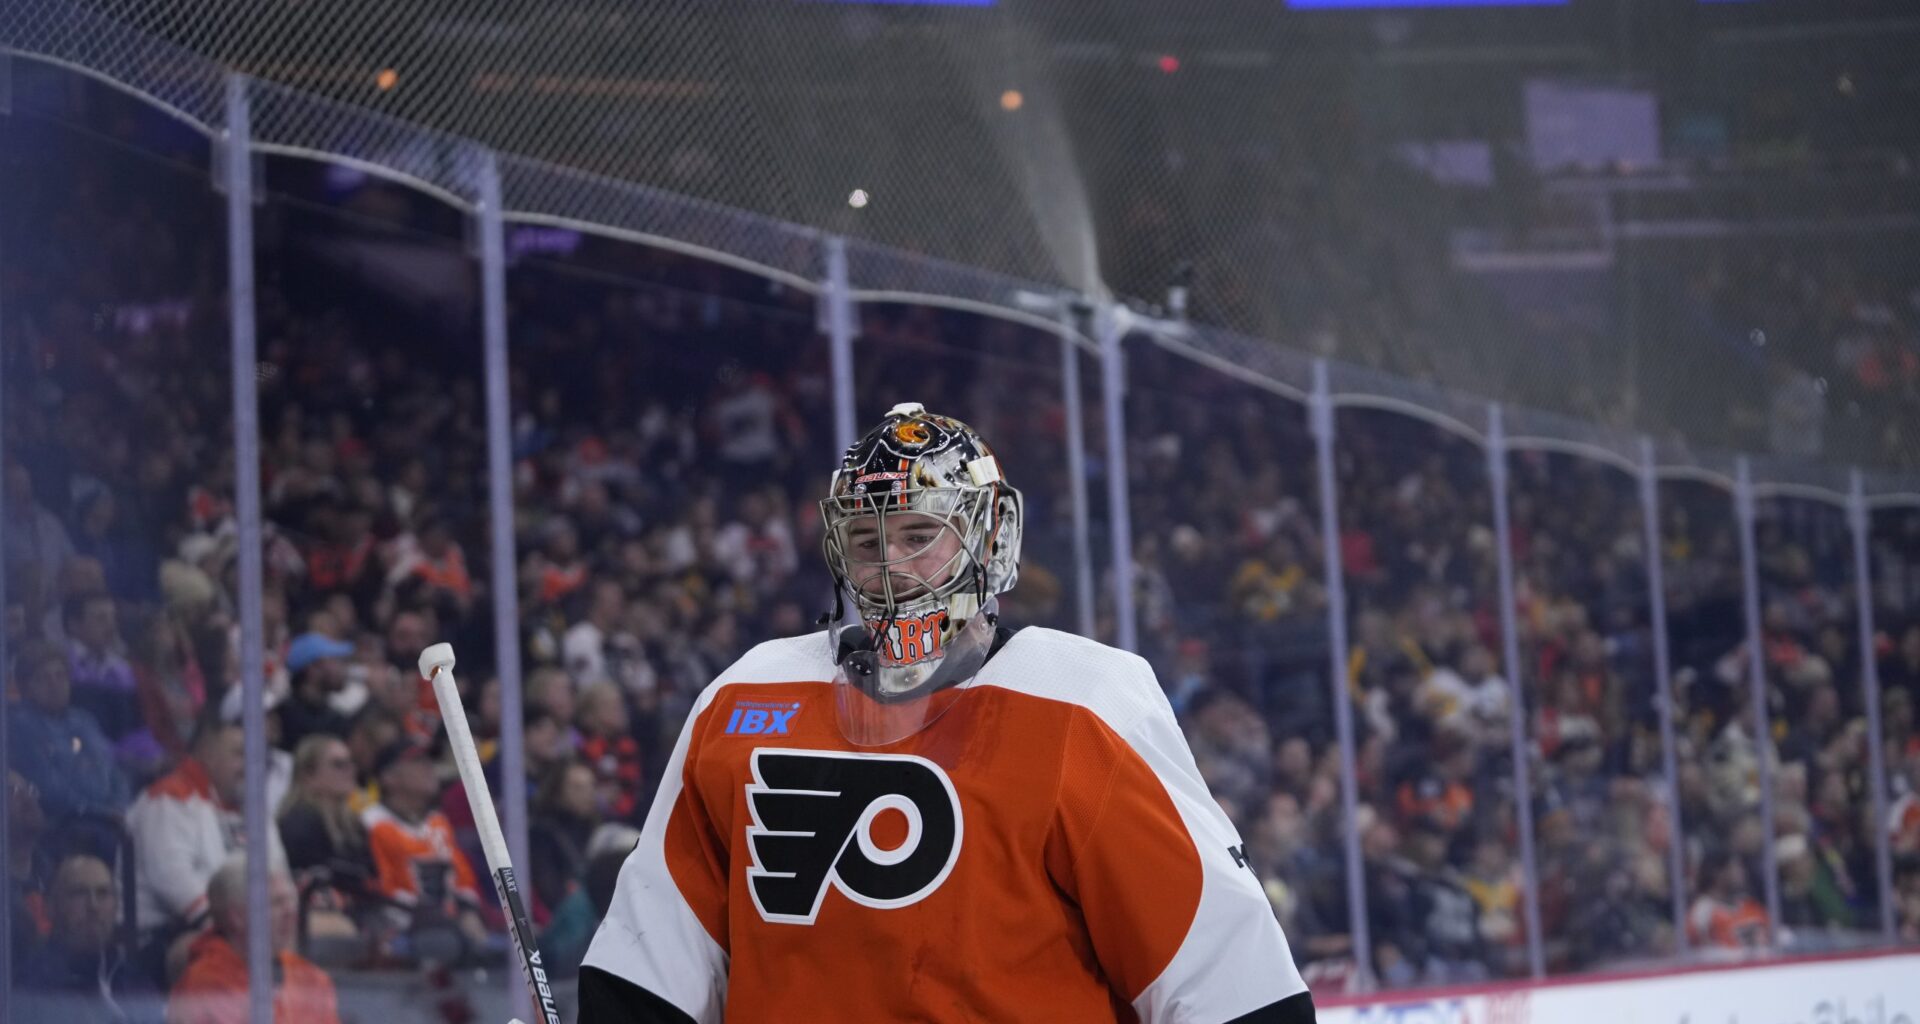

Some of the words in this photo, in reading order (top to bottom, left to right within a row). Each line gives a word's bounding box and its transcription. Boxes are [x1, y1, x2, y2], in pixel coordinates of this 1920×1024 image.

[864, 609, 947, 668] ART
[725, 708, 797, 734] IBX
[502, 868, 517, 893] HART
